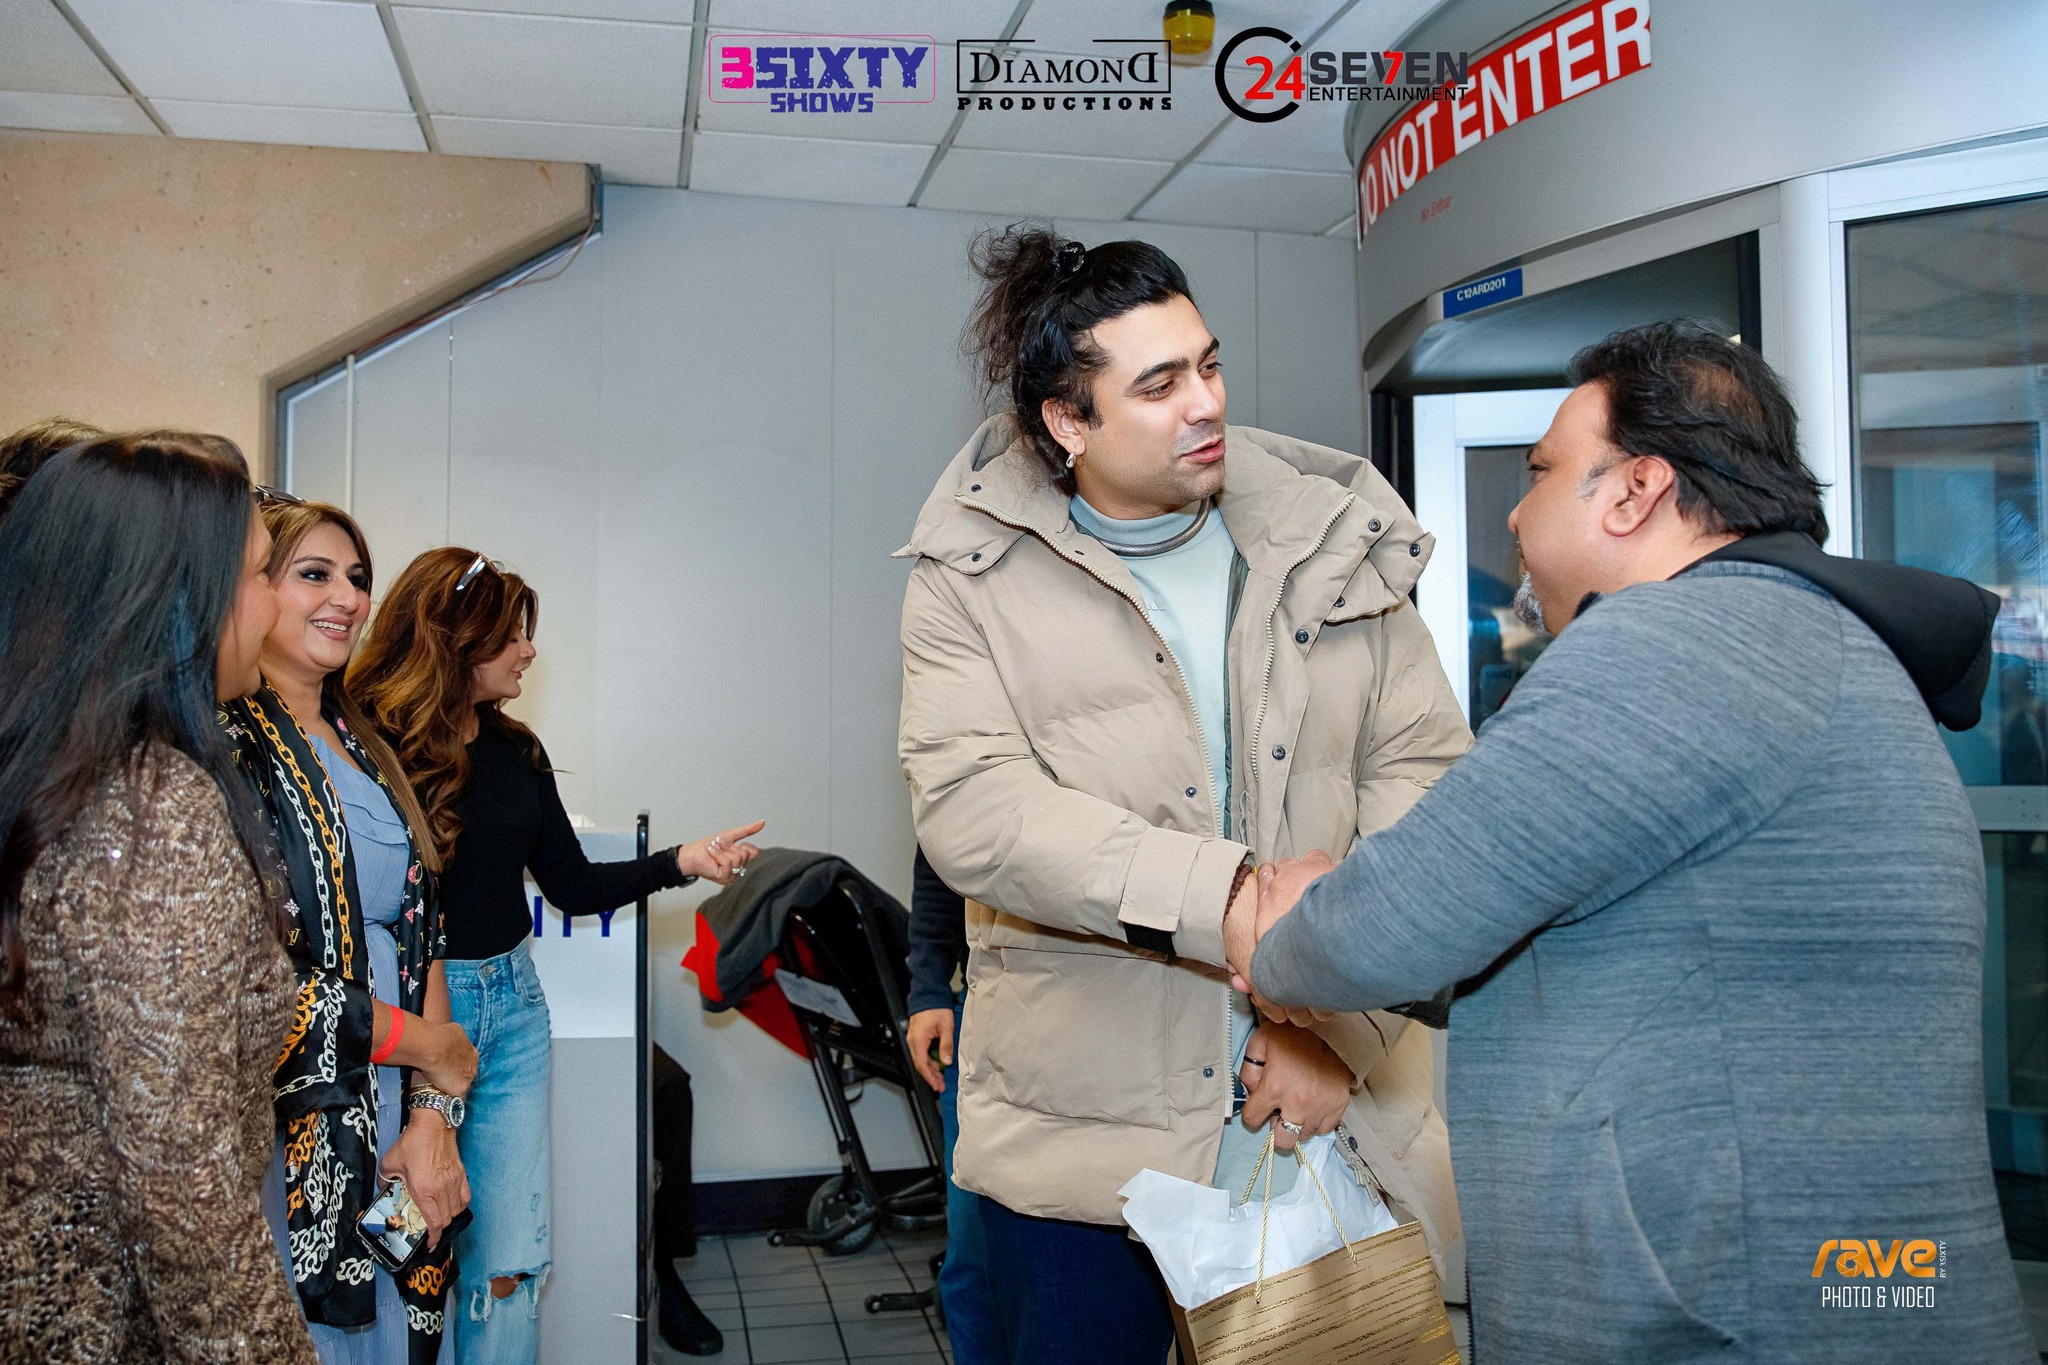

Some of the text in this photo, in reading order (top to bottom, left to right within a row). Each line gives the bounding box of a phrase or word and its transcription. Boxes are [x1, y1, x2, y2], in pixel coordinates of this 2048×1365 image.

[1381, 101, 1438, 209] NOT
[1451, 0, 1651, 156] ENTER
[1457, 277, 1506, 301] C12ARD201
